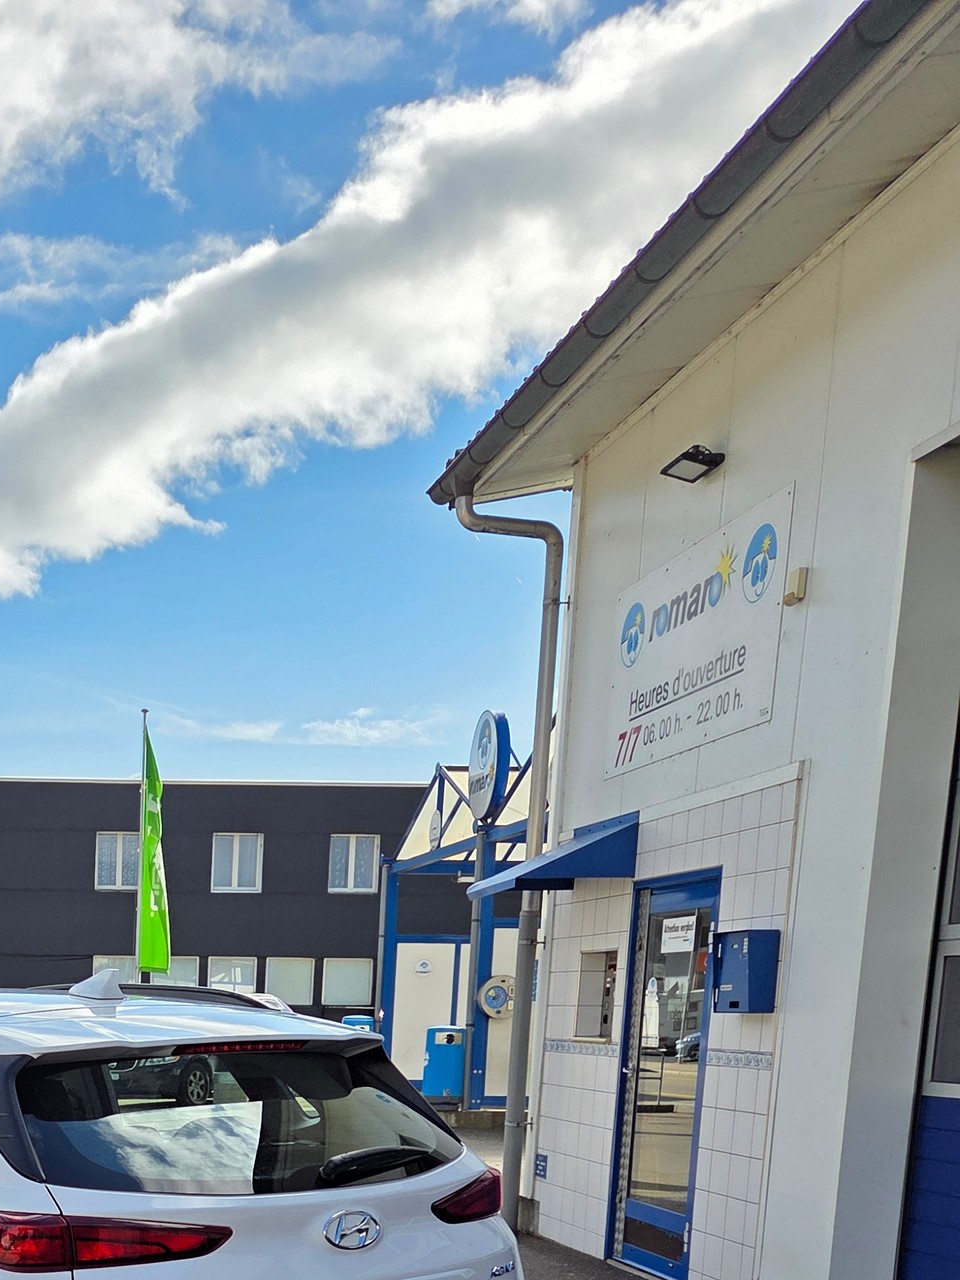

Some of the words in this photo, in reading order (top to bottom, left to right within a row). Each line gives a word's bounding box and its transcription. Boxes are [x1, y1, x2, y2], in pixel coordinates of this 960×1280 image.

[648, 571, 723, 643] romaro
[628, 681, 669, 717] Heures
[672, 644, 747, 698] d'ouverture
[614, 724, 643, 769] 7/7
